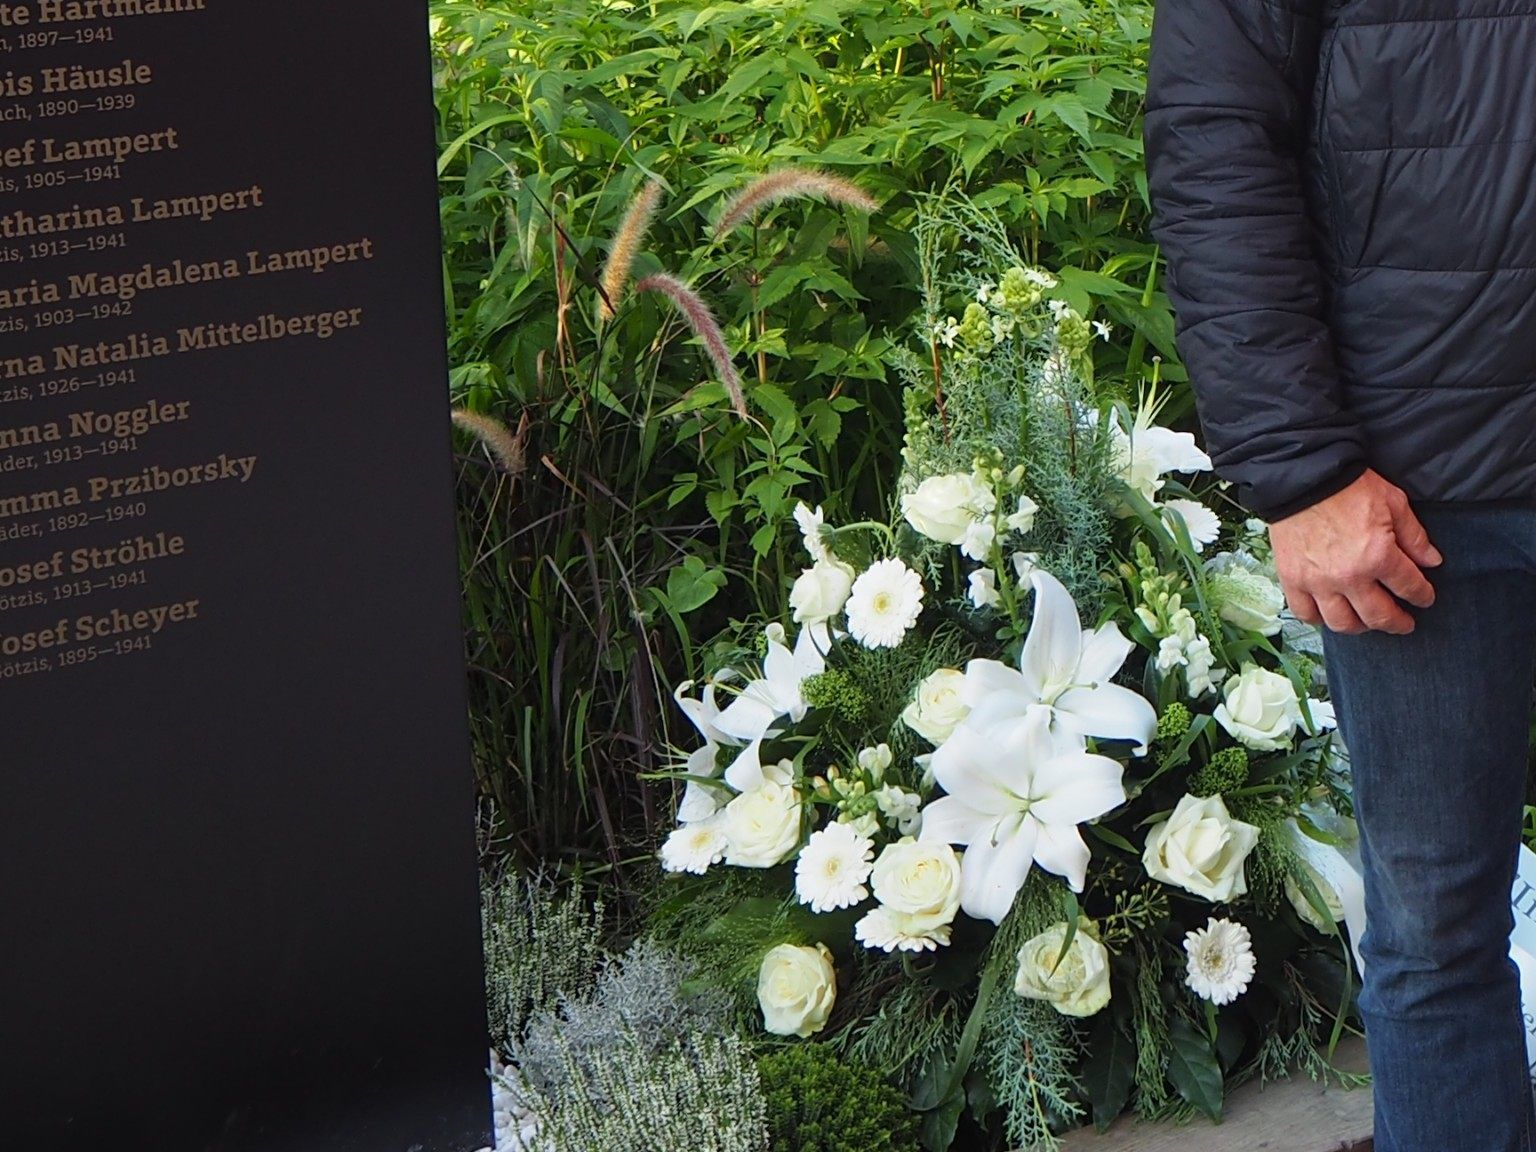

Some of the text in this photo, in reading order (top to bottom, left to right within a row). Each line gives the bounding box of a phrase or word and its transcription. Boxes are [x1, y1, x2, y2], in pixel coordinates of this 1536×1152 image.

[42, 60, 152, 93] Häusle
[43, 127, 178, 163] Lampert
[0, 185, 263, 239] tharina Lampert
[68, 259, 240, 300] Magdalena
[247, 237, 374, 275] Lampert
[53, 333, 170, 371] Natalia
[177, 308, 362, 353] Mittelberger
[69, 400, 190, 437] Noggler
[88, 454, 257, 501] Prziborsky
[70, 532, 185, 573] Ströhle
[0, 599, 199, 656] osef Scheyer
